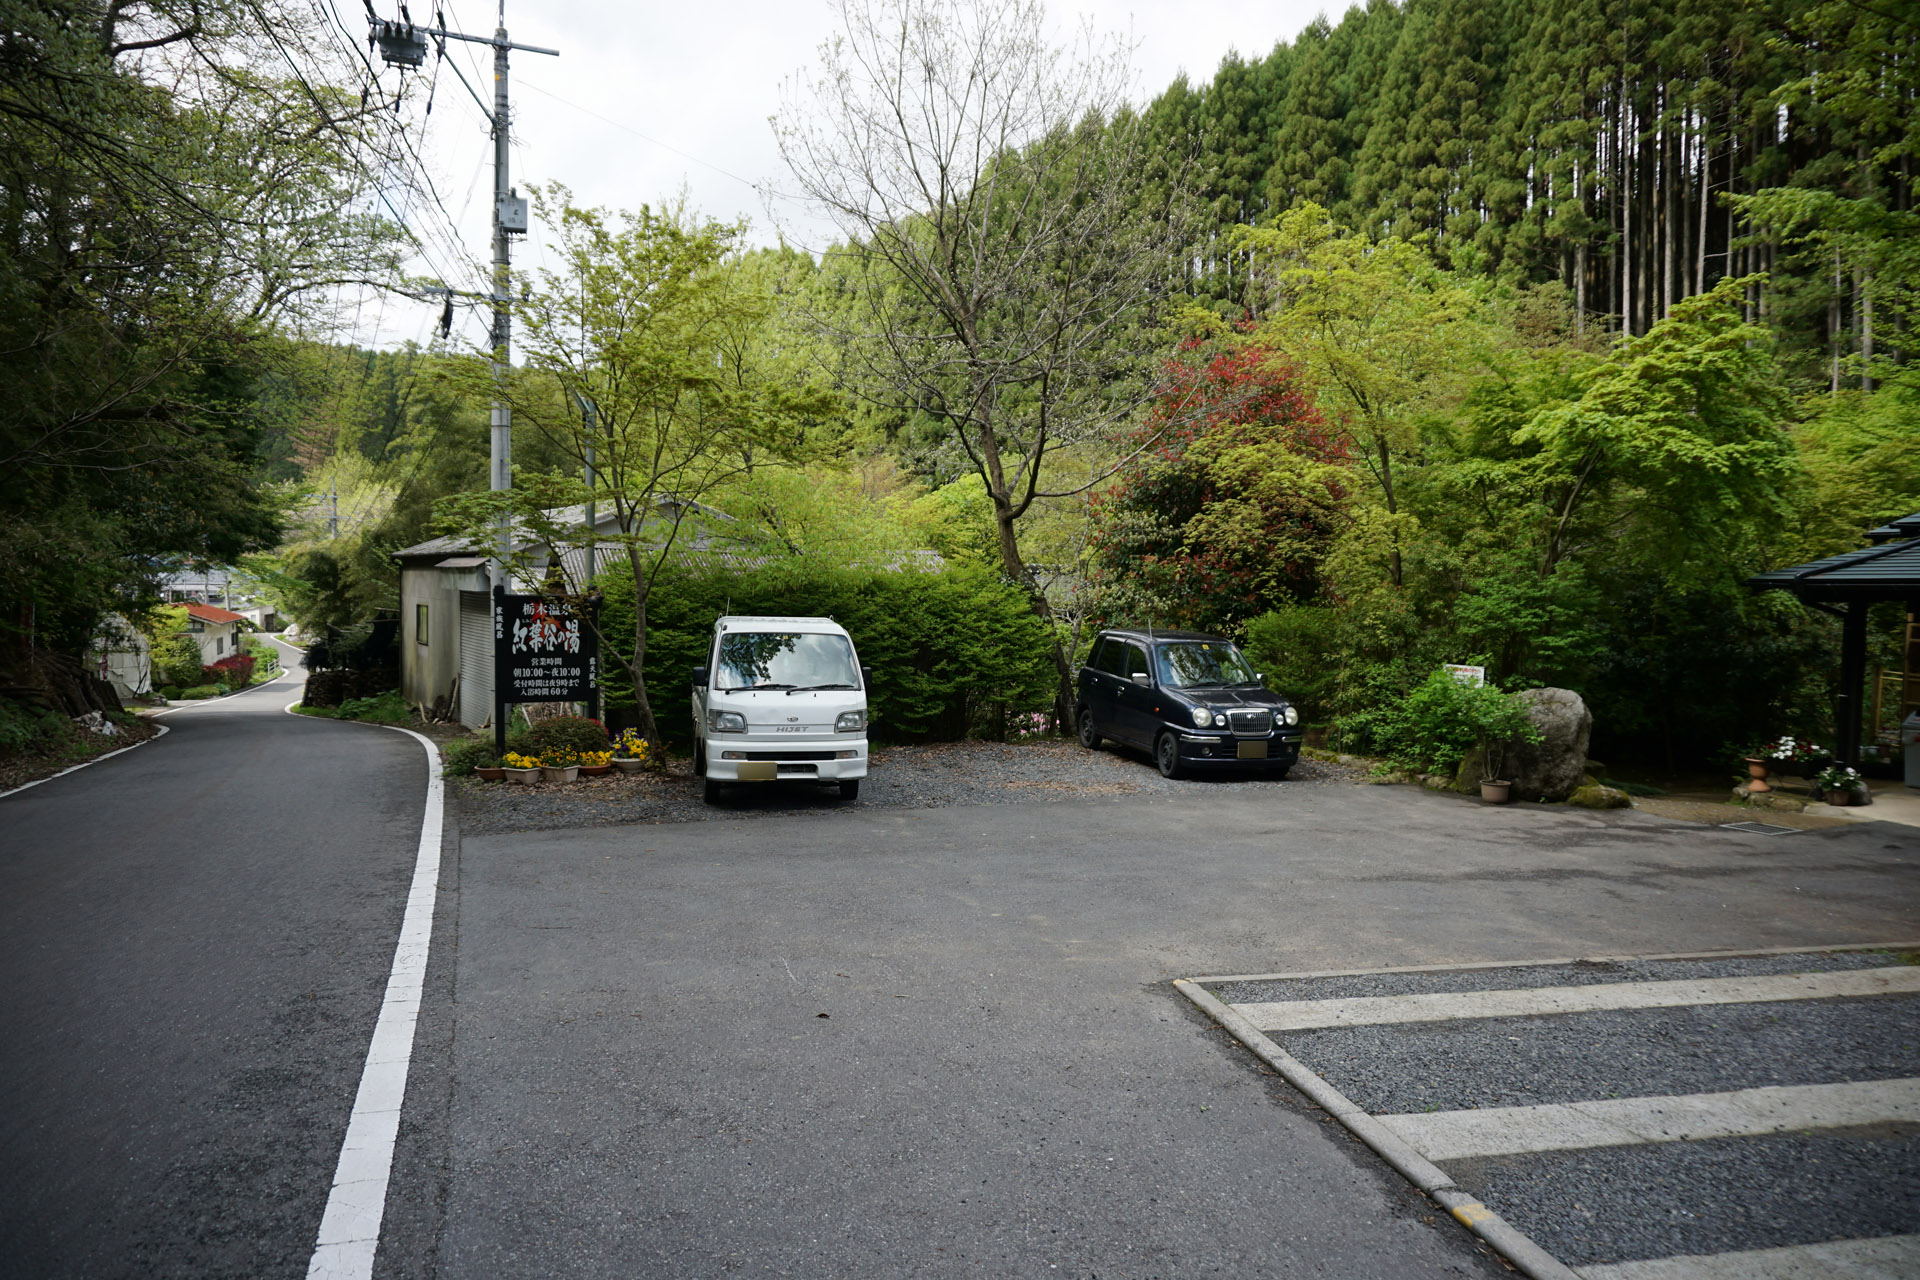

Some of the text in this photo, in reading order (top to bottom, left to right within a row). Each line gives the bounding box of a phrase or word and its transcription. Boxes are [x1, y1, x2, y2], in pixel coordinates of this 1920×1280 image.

[531, 657, 562, 666] 営業時間
[513, 679, 580, 688] 受付時間は夜9時まで
